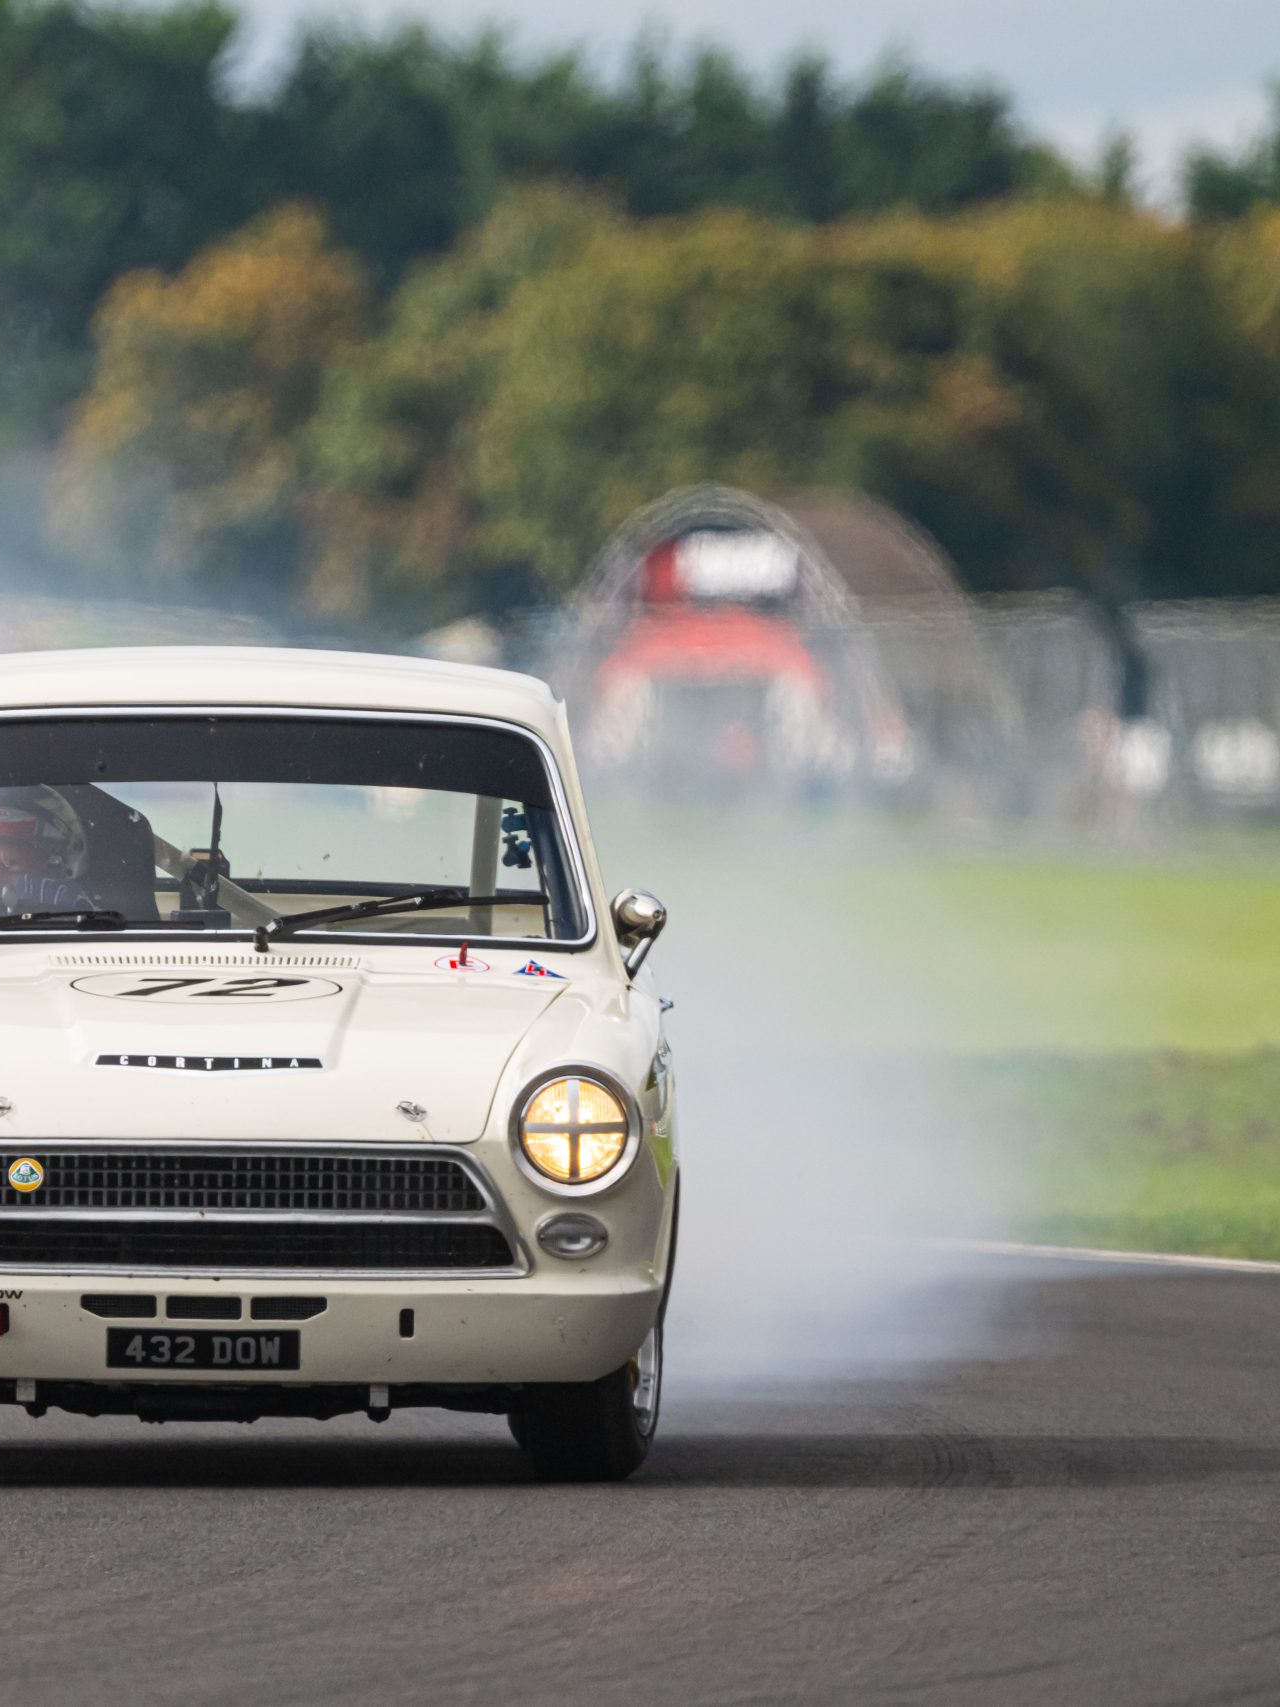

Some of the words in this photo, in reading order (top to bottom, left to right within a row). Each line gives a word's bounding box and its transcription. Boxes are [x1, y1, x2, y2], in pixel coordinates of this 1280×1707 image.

[116, 978, 310, 996] 72
[119, 1055, 299, 1070] CORTINA
[125, 1335, 195, 1364] 432
[212, 1336, 281, 1364] DOW
